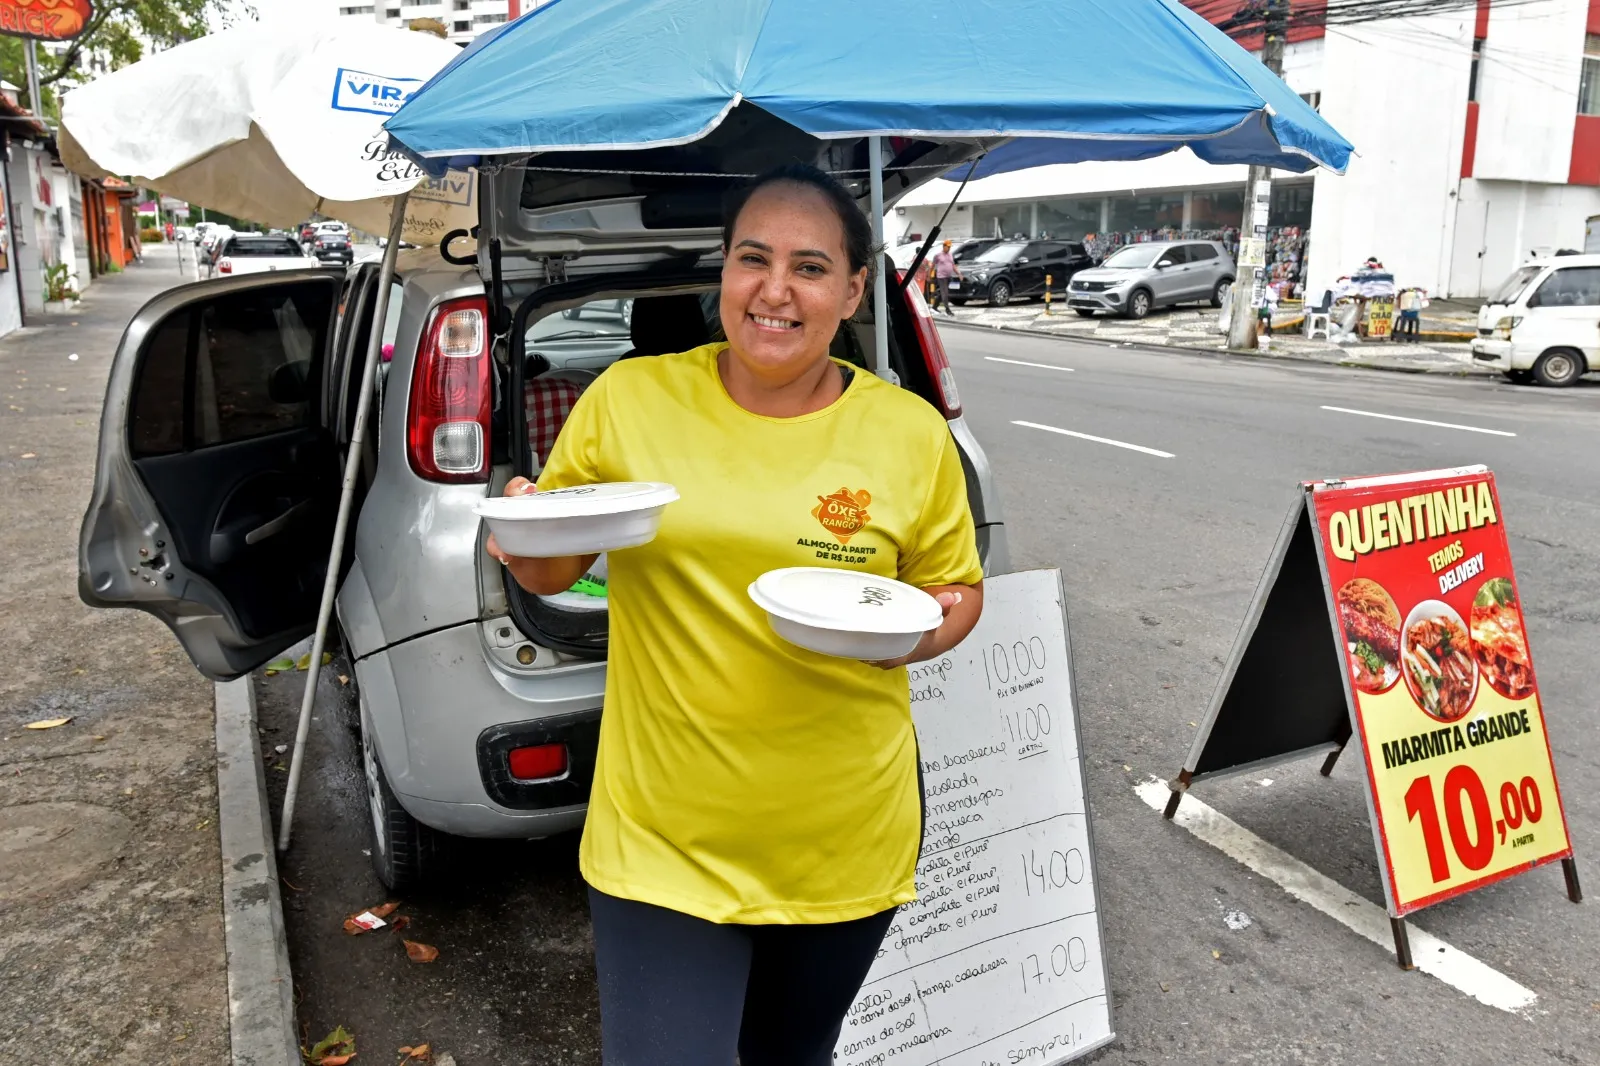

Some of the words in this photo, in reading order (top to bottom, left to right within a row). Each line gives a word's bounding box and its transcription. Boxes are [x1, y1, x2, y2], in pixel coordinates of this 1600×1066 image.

[372, 100, 403, 109] SALVA
[827, 501, 858, 518] ÔXE
[822, 517, 855, 530] RANGO
[1329, 481, 1498, 562] QUENTINHA
[797, 538, 839, 551] ALMOÇO
[849, 546, 876, 554] PARTIR
[816, 551, 829, 559] DE
[831, 553, 842, 562] R$
[844, 555, 866, 564] 10,00
[1428, 540, 1464, 574] TEMOS
[1438, 552, 1485, 595] DELIVERY
[906, 658, 953, 681] ango
[1381, 726, 1466, 769] MARMITA
[1466, 709, 1531, 747] GRANDE
[924, 814, 984, 838] anqueca
[920, 833, 960, 856] rango
[1517, 833, 1535, 847] PARTIR
[1022, 848, 1084, 896] 14,00
[1021, 937, 1086, 993] 17,00
